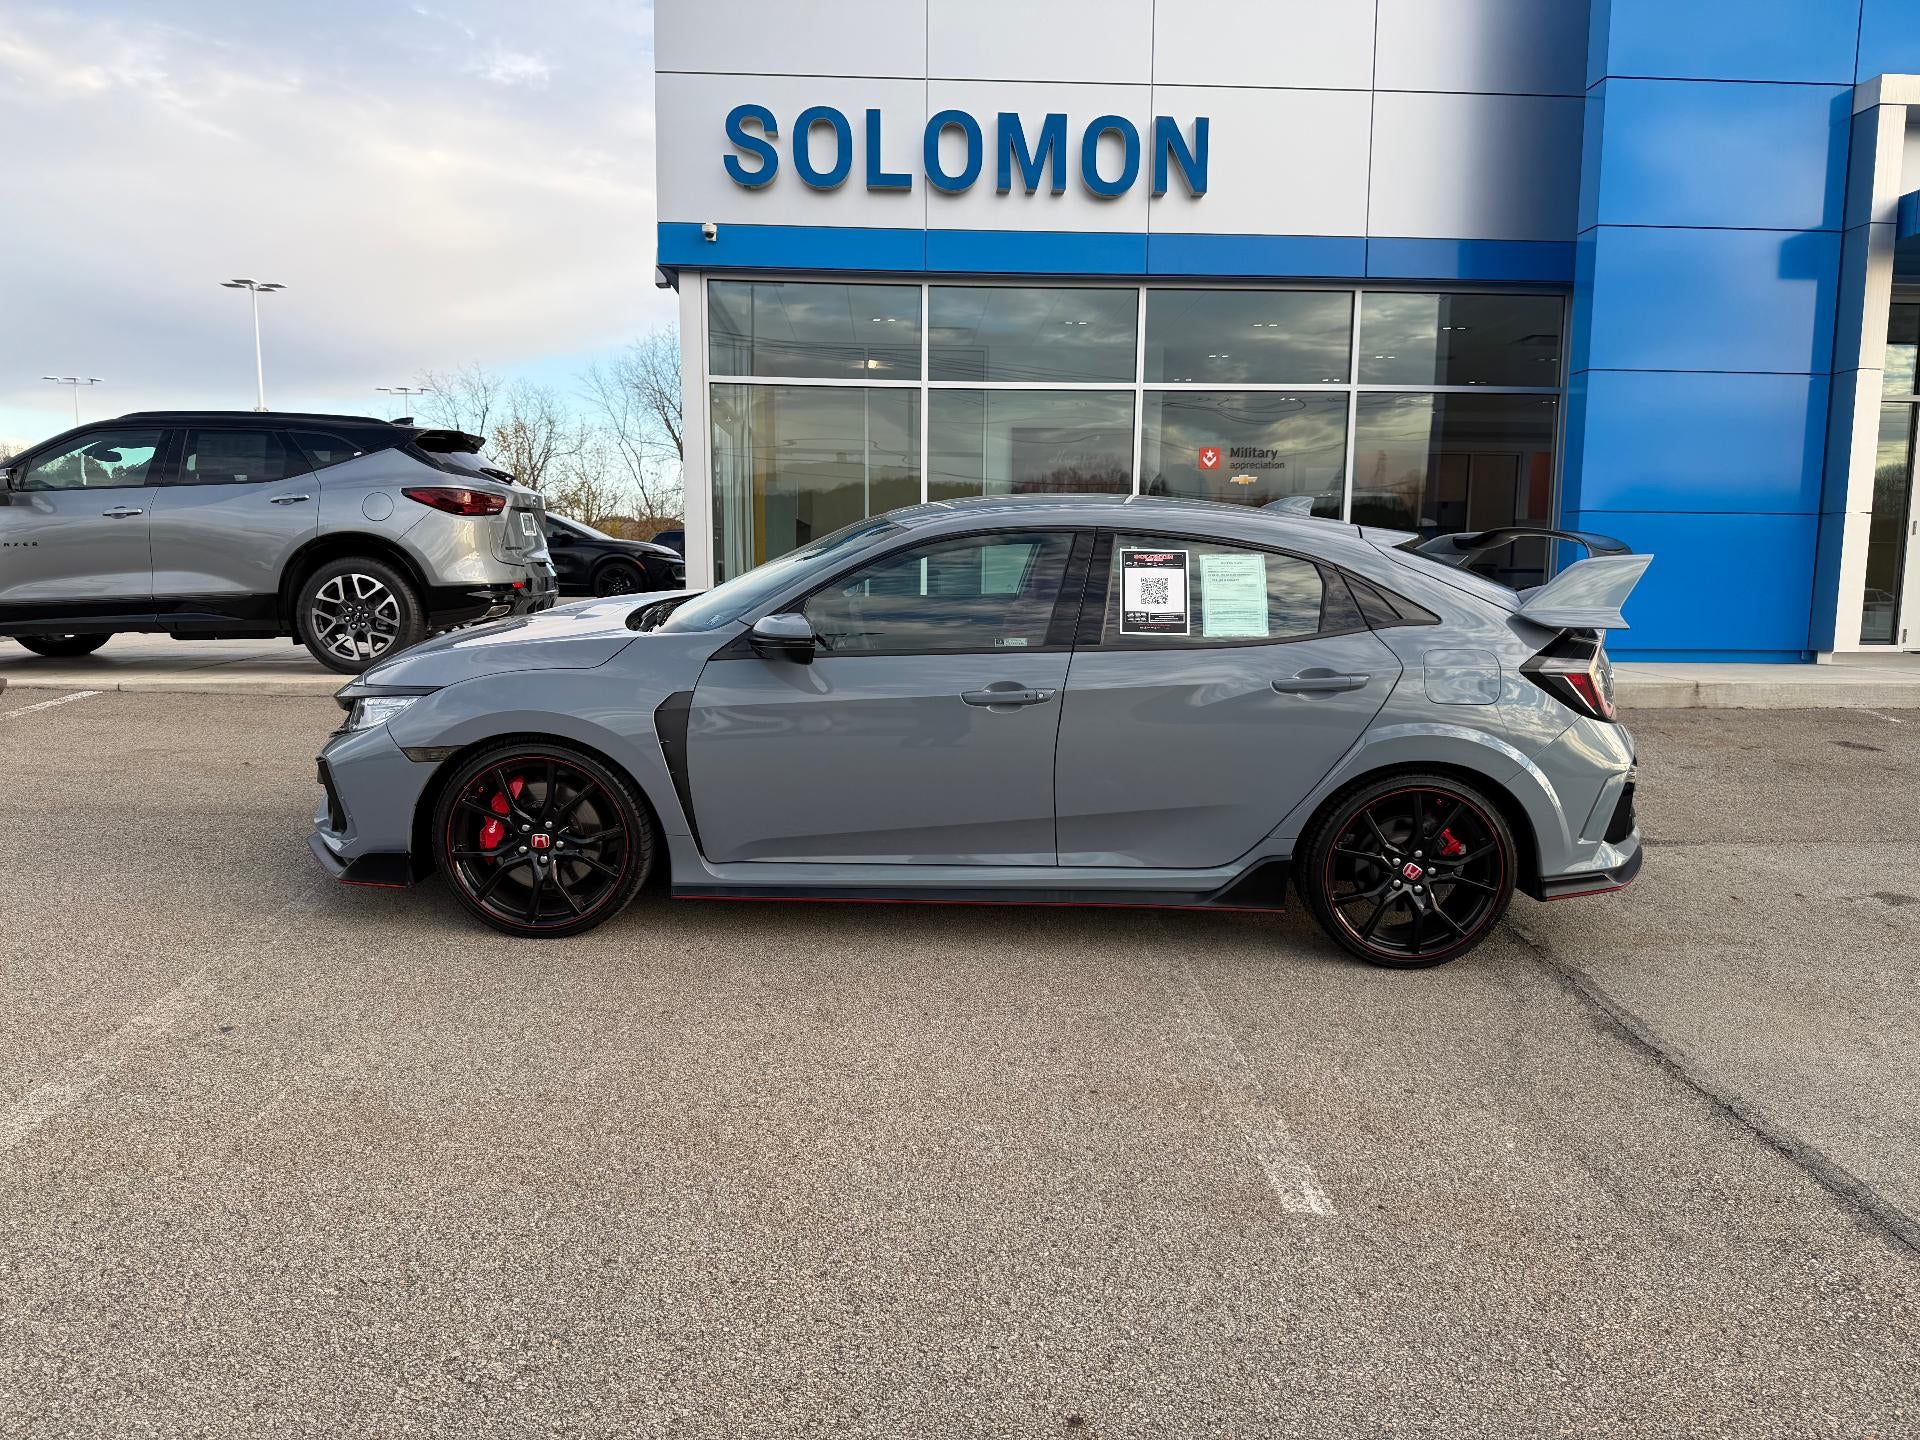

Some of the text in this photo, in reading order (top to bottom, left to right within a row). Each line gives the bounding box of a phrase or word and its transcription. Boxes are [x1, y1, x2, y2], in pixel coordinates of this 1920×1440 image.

[723, 103, 1210, 199] SOLOMON
[1230, 447, 1278, 460] Military
[1230, 461, 1285, 470] appreciation
